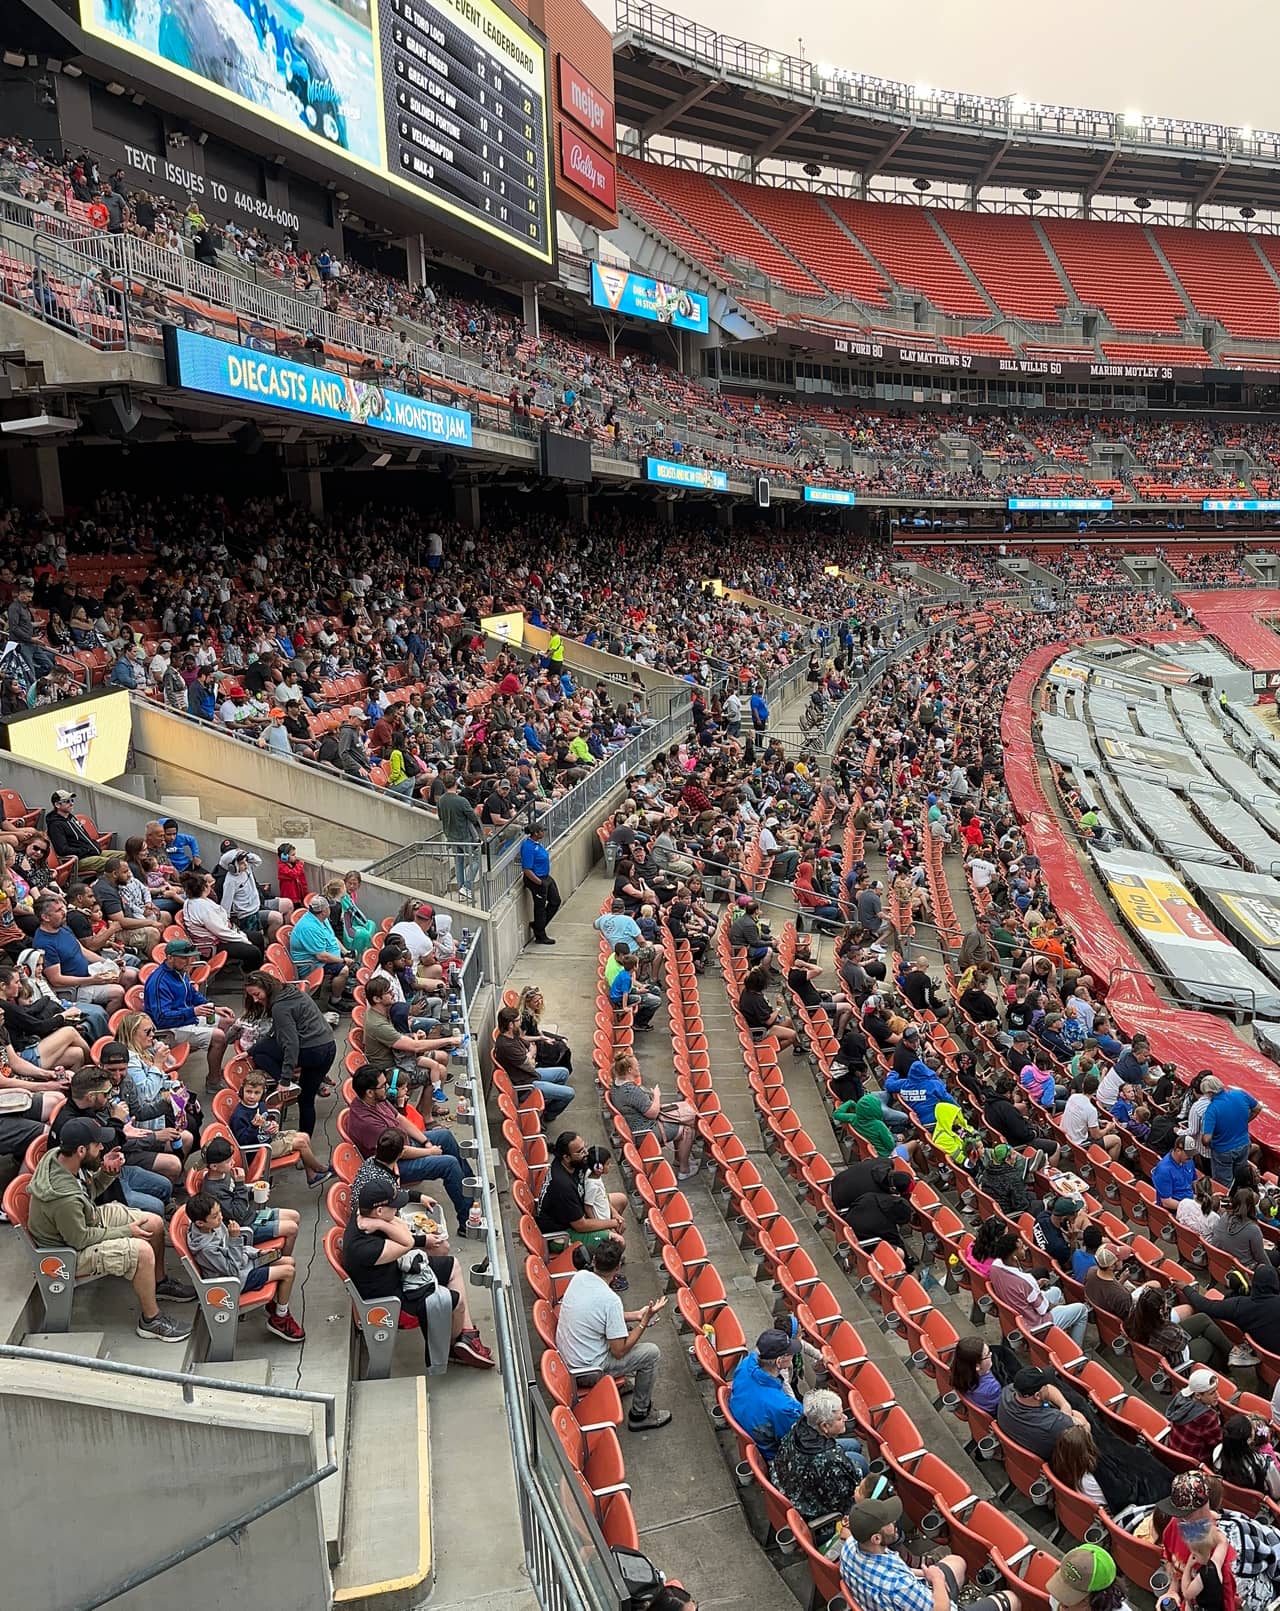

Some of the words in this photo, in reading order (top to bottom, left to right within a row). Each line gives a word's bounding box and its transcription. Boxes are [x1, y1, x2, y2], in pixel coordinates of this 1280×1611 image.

[396, 30, 402, 42] 2
[455, 0, 482, 28] EVENT
[483, 17, 534, 74] LEADERBOARD
[398, 61, 404, 72] 3
[400, 93, 405, 104] 4
[571, 81, 605, 129] meijer
[401, 123, 408, 135] 5
[413, 157, 435, 179] MAX-D
[570, 145, 596, 188] Bally
[124, 145, 157, 175] TEXT
[164, 161, 204, 195] ISSUES
[210, 180, 228, 203] TO
[234, 190, 300, 232] 440-824-6000
[834, 339, 848, 351] LEN
[851, 342, 871, 355] FORD
[872, 345, 883, 358] 80
[900, 349, 916, 361] CLAY
[917, 350, 960, 366] MATTHEWS
[961, 356, 972, 368] 57
[999, 360, 1018, 371] BILL
[1019, 361, 1048, 372] WILLIS
[1050, 362, 1062, 374] 60
[1090, 365, 1123, 376] MARION
[1125, 366, 1158, 378] MOTLEY
[1161, 367, 1173, 379] 36
[228, 355, 308, 402] DIECASTS
[311, 380, 343, 409] AND
[395, 407, 445, 434] MONSTER
[442, 412, 468, 440] JAM.
[56, 726, 97, 751] MONSTER
[1129, 894, 1162, 924] Ohio
[1186, 912, 1213, 935] Ohio
